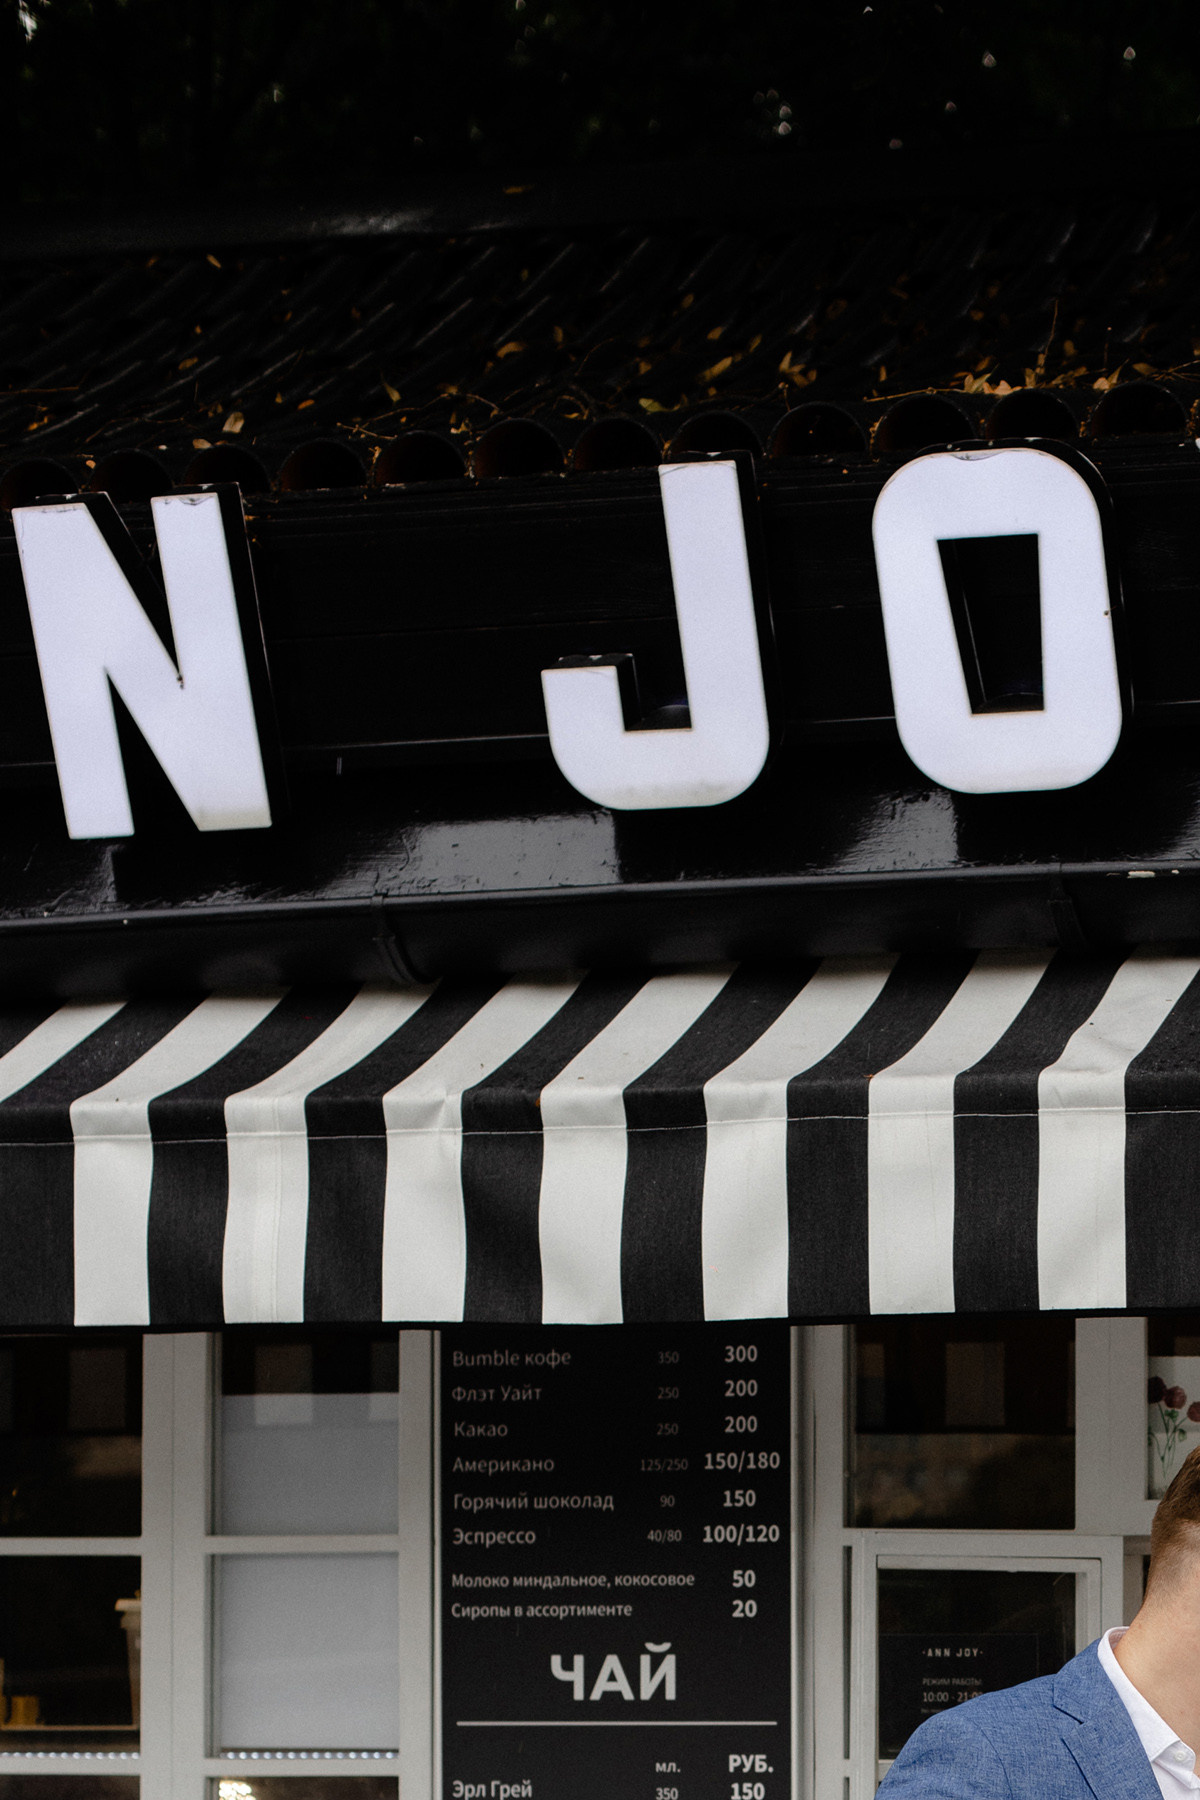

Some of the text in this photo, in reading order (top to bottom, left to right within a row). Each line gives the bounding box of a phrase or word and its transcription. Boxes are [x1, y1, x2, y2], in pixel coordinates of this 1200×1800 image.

[453, 1345, 757, 1368] Bumble кофе 350 300
[452, 1380, 757, 1401] Флэт Уайт 250 200
[455, 1416, 757, 1437] Какао 250 200
[453, 1451, 780, 1476] Американо 125/250 150/180
[454, 1490, 756, 1513] Горячий шоколад 90 150
[453, 1524, 779, 1548] Эспрессо 40/80 100/120
[452, 1570, 755, 1589] Молоко миндальное, кокосовое 50
[452, 1600, 757, 1620] Сиропы в ассортименте 20
[551, 1643, 676, 1700] ЧАЙ
[923, 1691, 949, 1702] 10:00
[656, 1754, 773, 1773] мл. РУБ.
[453, 1780, 765, 1800] Эрл Грей 350 150
